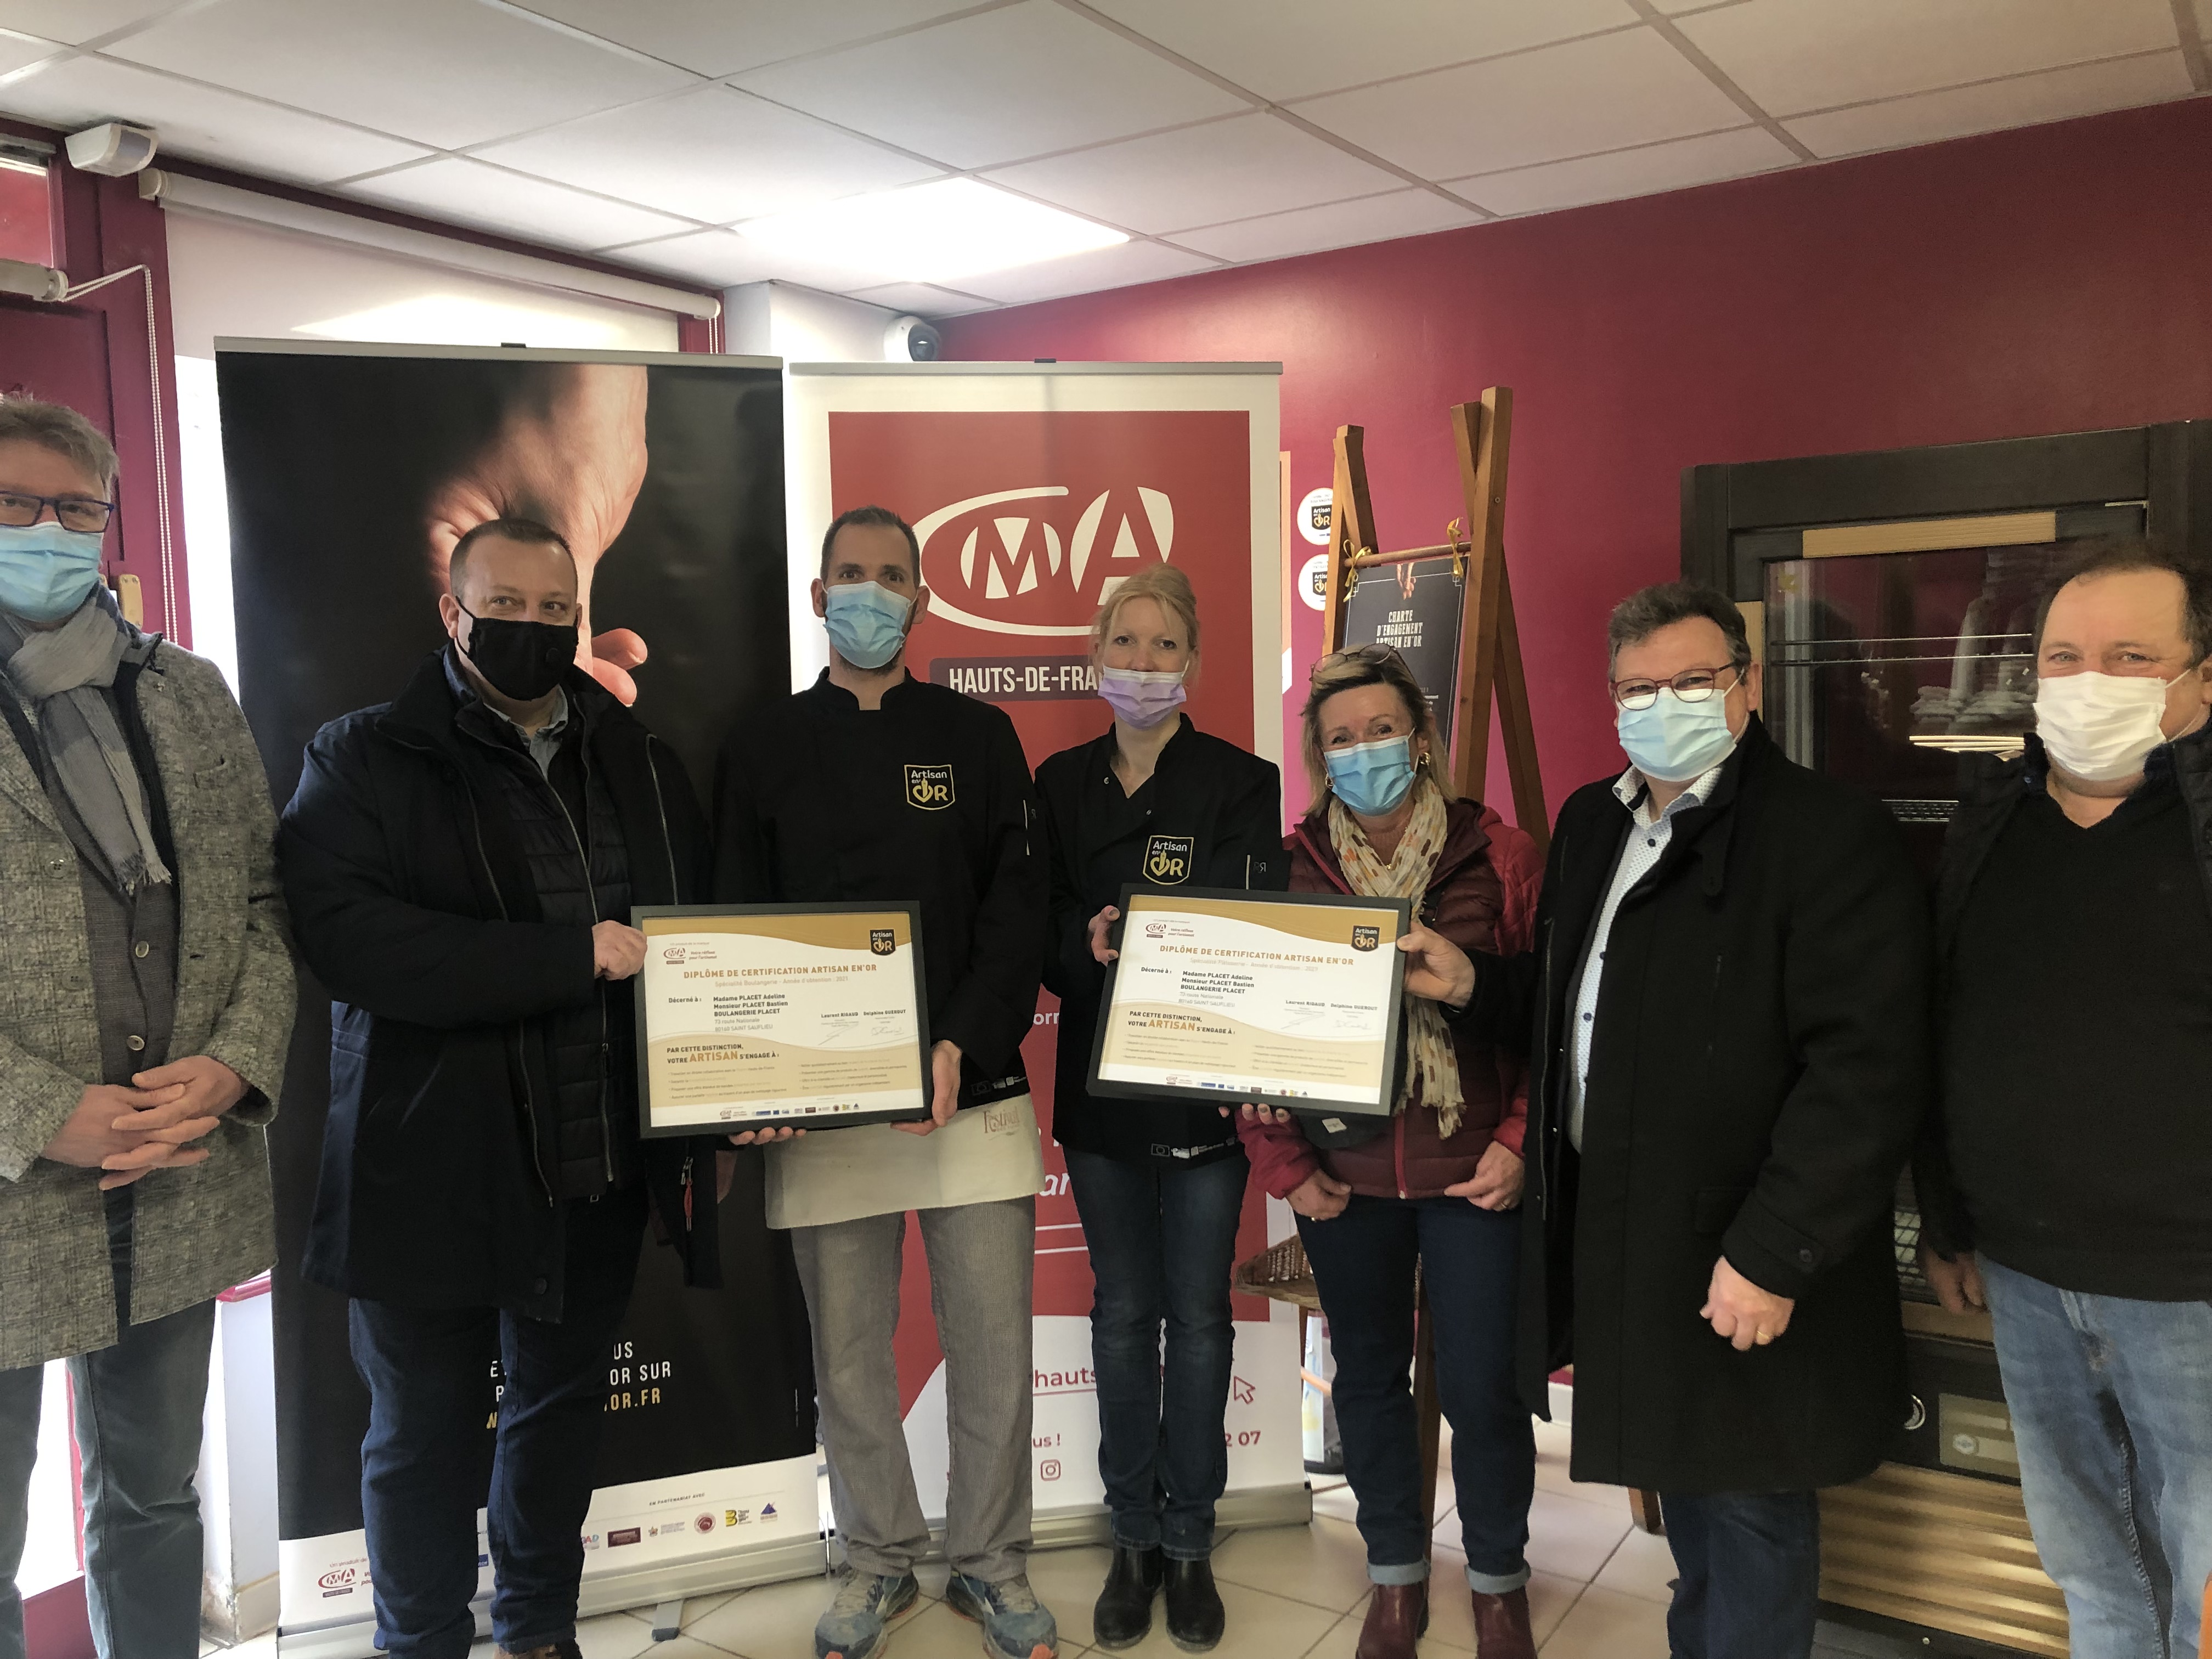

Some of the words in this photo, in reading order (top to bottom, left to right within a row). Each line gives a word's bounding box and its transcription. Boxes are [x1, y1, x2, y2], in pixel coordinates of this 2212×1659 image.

[911, 486, 1174, 635] CMA
[1389, 610, 1413, 623] CHARTE
[1376, 622, 1423, 636] D'ENGAGEMENT
[1403, 635, 1422, 648] EN'OR
[949, 665, 1102, 693] HAUTS-DE-FRA
[911, 770, 947, 778] Artisan
[1153, 840, 1187, 852] Artisan
[1160, 945, 1198, 954] DIPLÔME
[1214, 949, 1282, 960] CERTIFICATION
[1284, 954, 1324, 963] ARTISAN
[1326, 957, 1353, 966] EN'OR
[684, 968, 724, 979] DIPLÔME
[741, 967, 809, 977] CERTIFICATION
[811, 966, 849, 974] ARTISAN
[1181, 984, 1221, 992] BOULANGERIE
[1163, 1014, 1202, 1022] DISTINCTION,
[1148, 1019, 1195, 1031] ARTISAN
[690, 1051, 738, 1063] ARTISAN
[610, 1367, 631, 1385] OR
[639, 1361, 671, 1381] SUR
[604, 1387, 661, 1412] OR.FR
[1032, 1436, 1052, 1448] us
[1238, 1430, 1261, 1446] 07
